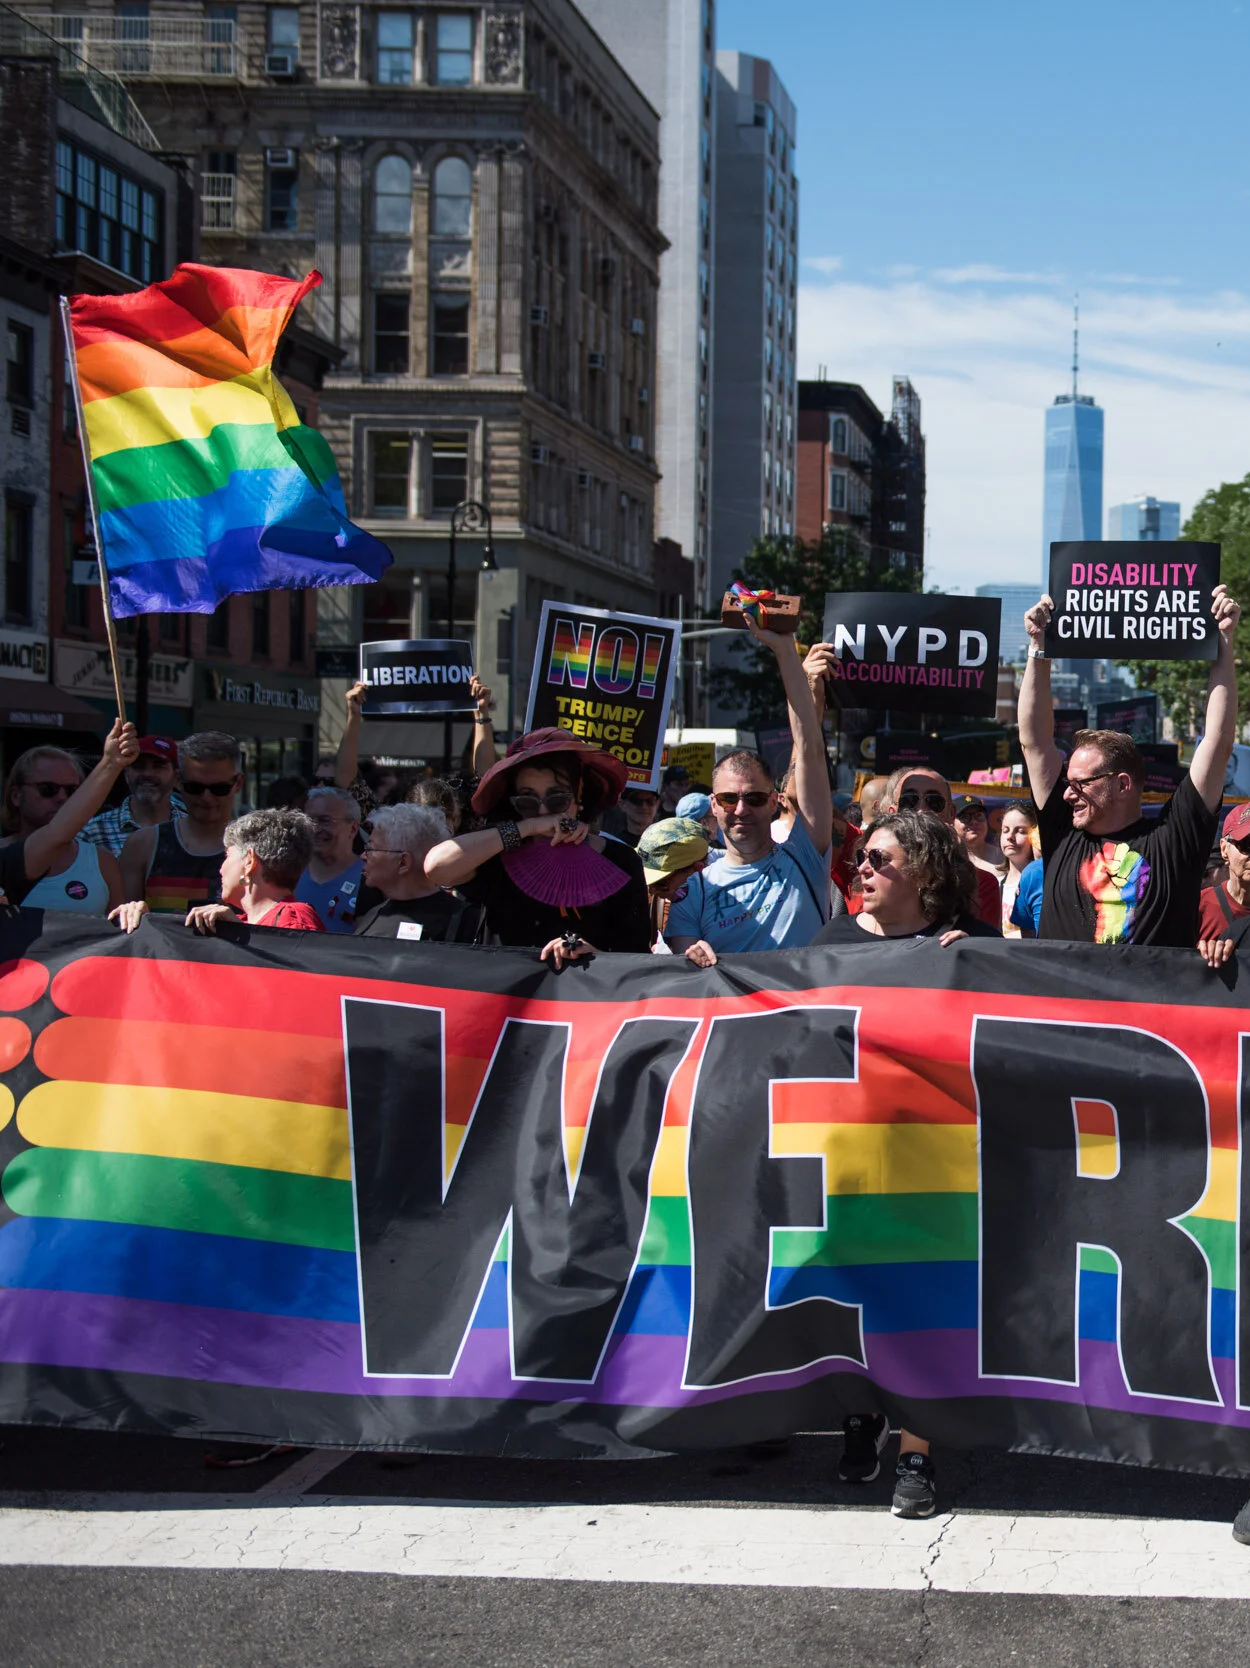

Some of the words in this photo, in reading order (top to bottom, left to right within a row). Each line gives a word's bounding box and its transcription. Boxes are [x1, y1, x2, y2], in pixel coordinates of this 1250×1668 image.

[1070, 562, 1198, 587] DISABILITY
[1065, 589, 1149, 613] RIGHTS
[1154, 589, 1201, 613] ARE
[1057, 615, 1115, 640] CIVIL
[1122, 616, 1207, 641] RIGHTS
[547, 618, 665, 699] NO!
[834, 623, 989, 667] NYPD
[362, 664, 473, 687] LIBERATION
[834, 661, 985, 689] ACCOUNTABILITY
[225, 678, 252, 703] FIRST
[253, 681, 296, 710] REPUBLIC
[297, 687, 320, 712] BANK
[555, 696, 645, 727] TRUMP/
[557, 717, 635, 744] PENCE
[609, 744, 652, 767] GO!
[339, 995, 868, 1392] WE
